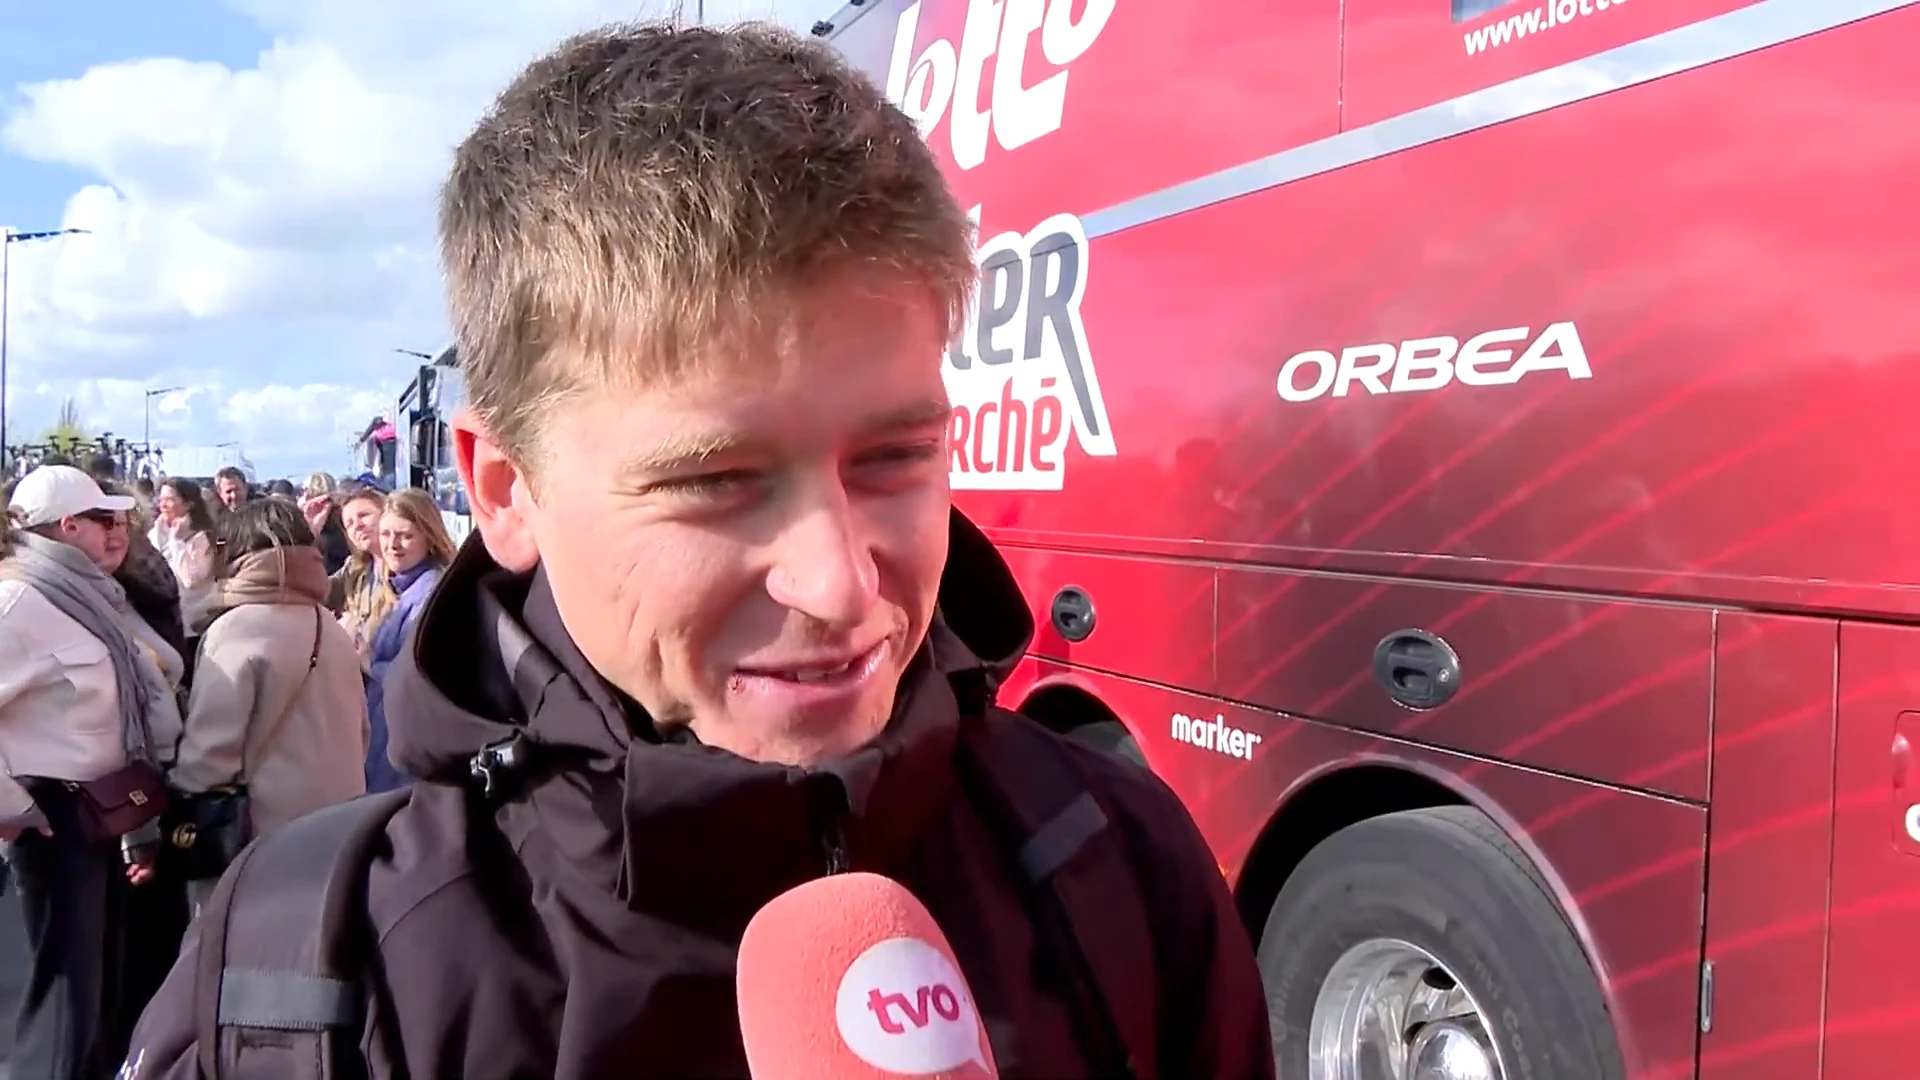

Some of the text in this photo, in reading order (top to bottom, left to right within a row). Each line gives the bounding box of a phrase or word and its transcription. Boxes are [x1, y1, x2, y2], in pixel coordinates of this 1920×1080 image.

[1276, 321, 1593, 402] ORBEA
[1171, 713, 1262, 761] marker
[867, 983, 960, 1035] tvo
